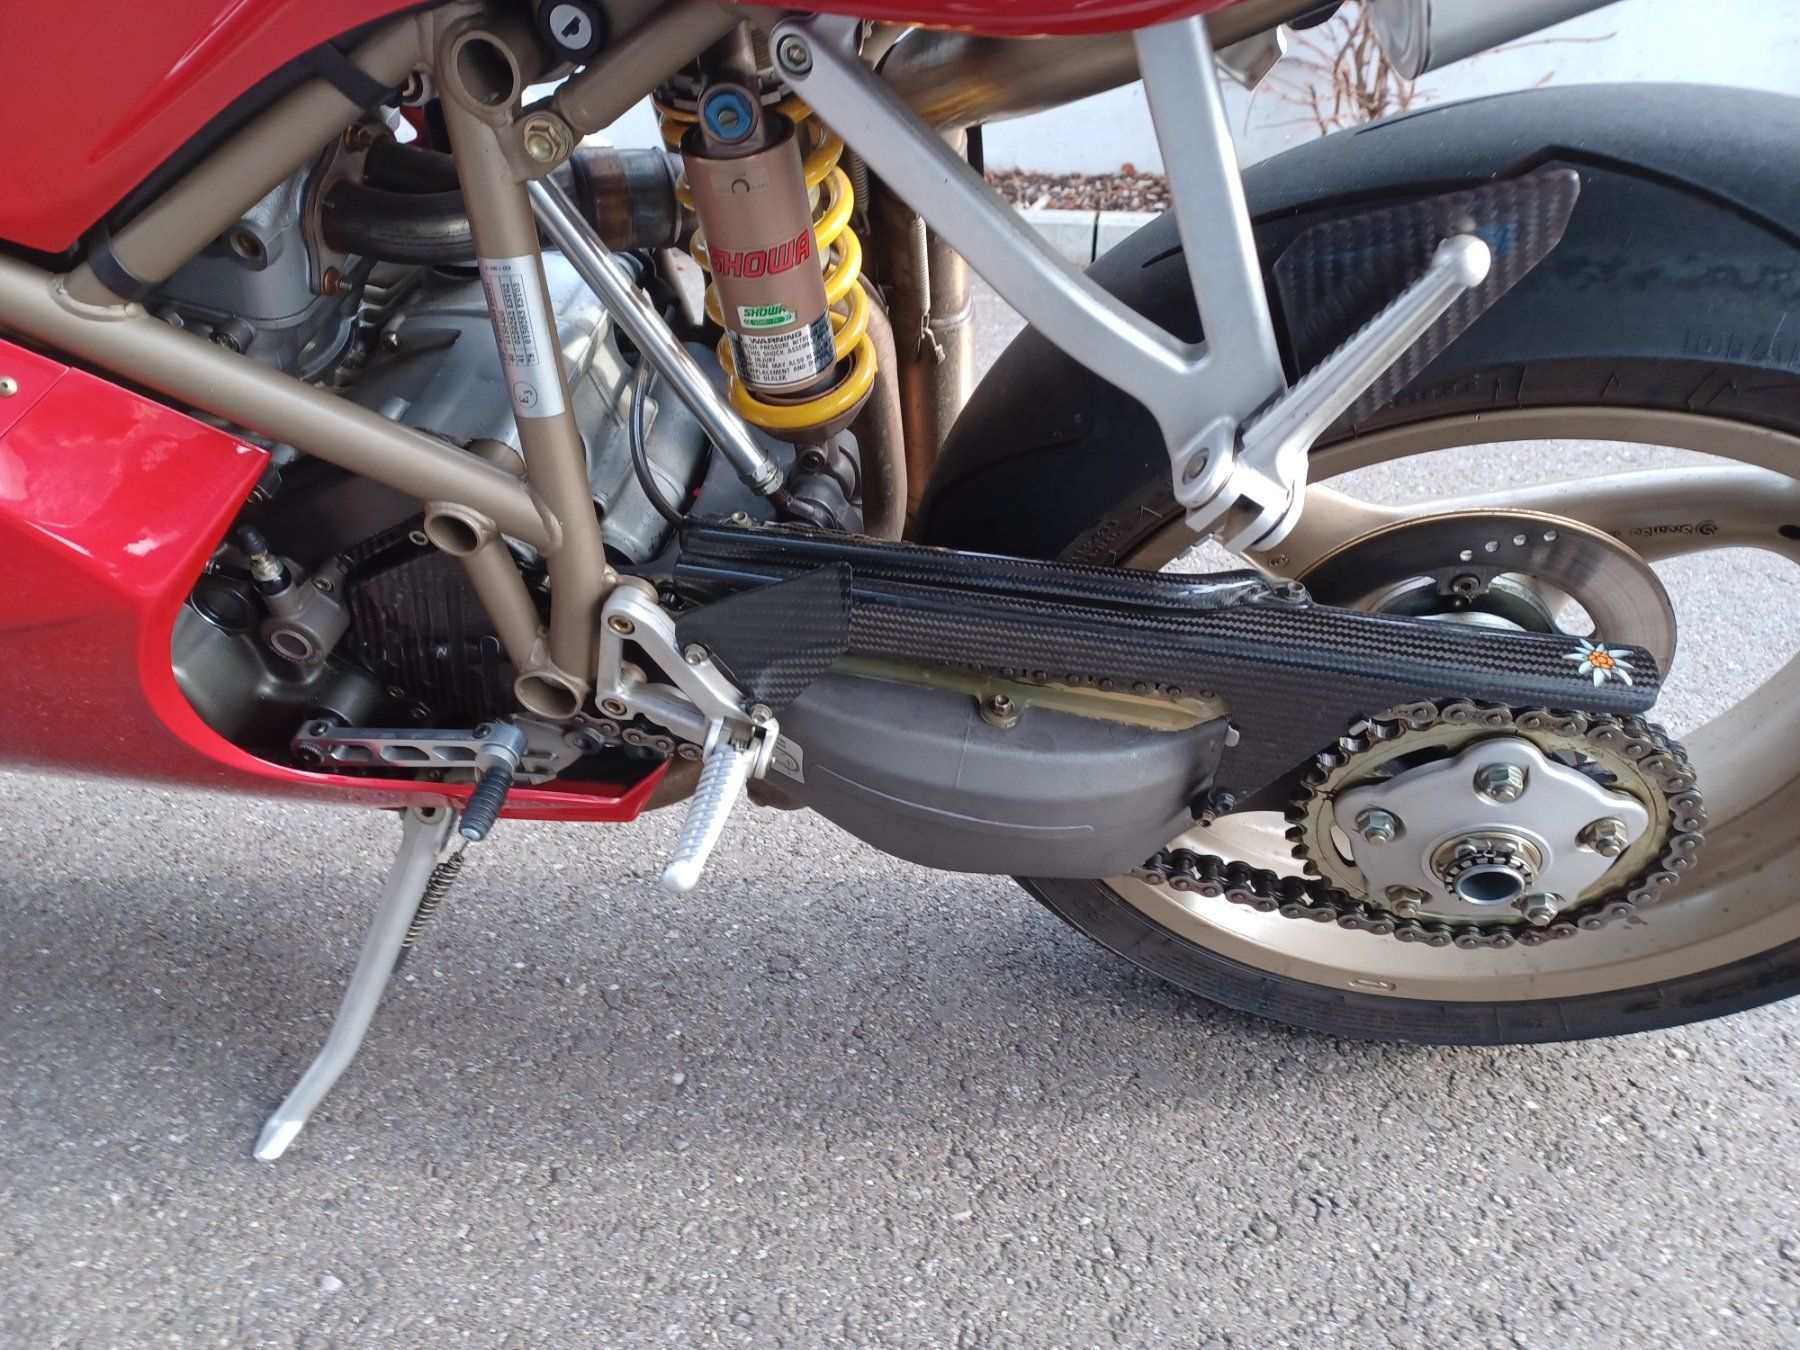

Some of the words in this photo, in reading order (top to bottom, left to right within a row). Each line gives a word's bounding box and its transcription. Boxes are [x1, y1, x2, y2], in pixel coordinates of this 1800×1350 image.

[709, 229, 810, 278] SHOWA
[749, 330, 803, 345] WARNING
[760, 342, 790, 351] PRESSURE
[763, 350, 785, 358] SHOCK
[788, 358, 805, 368] ALSO
[793, 364, 806, 373] AND
